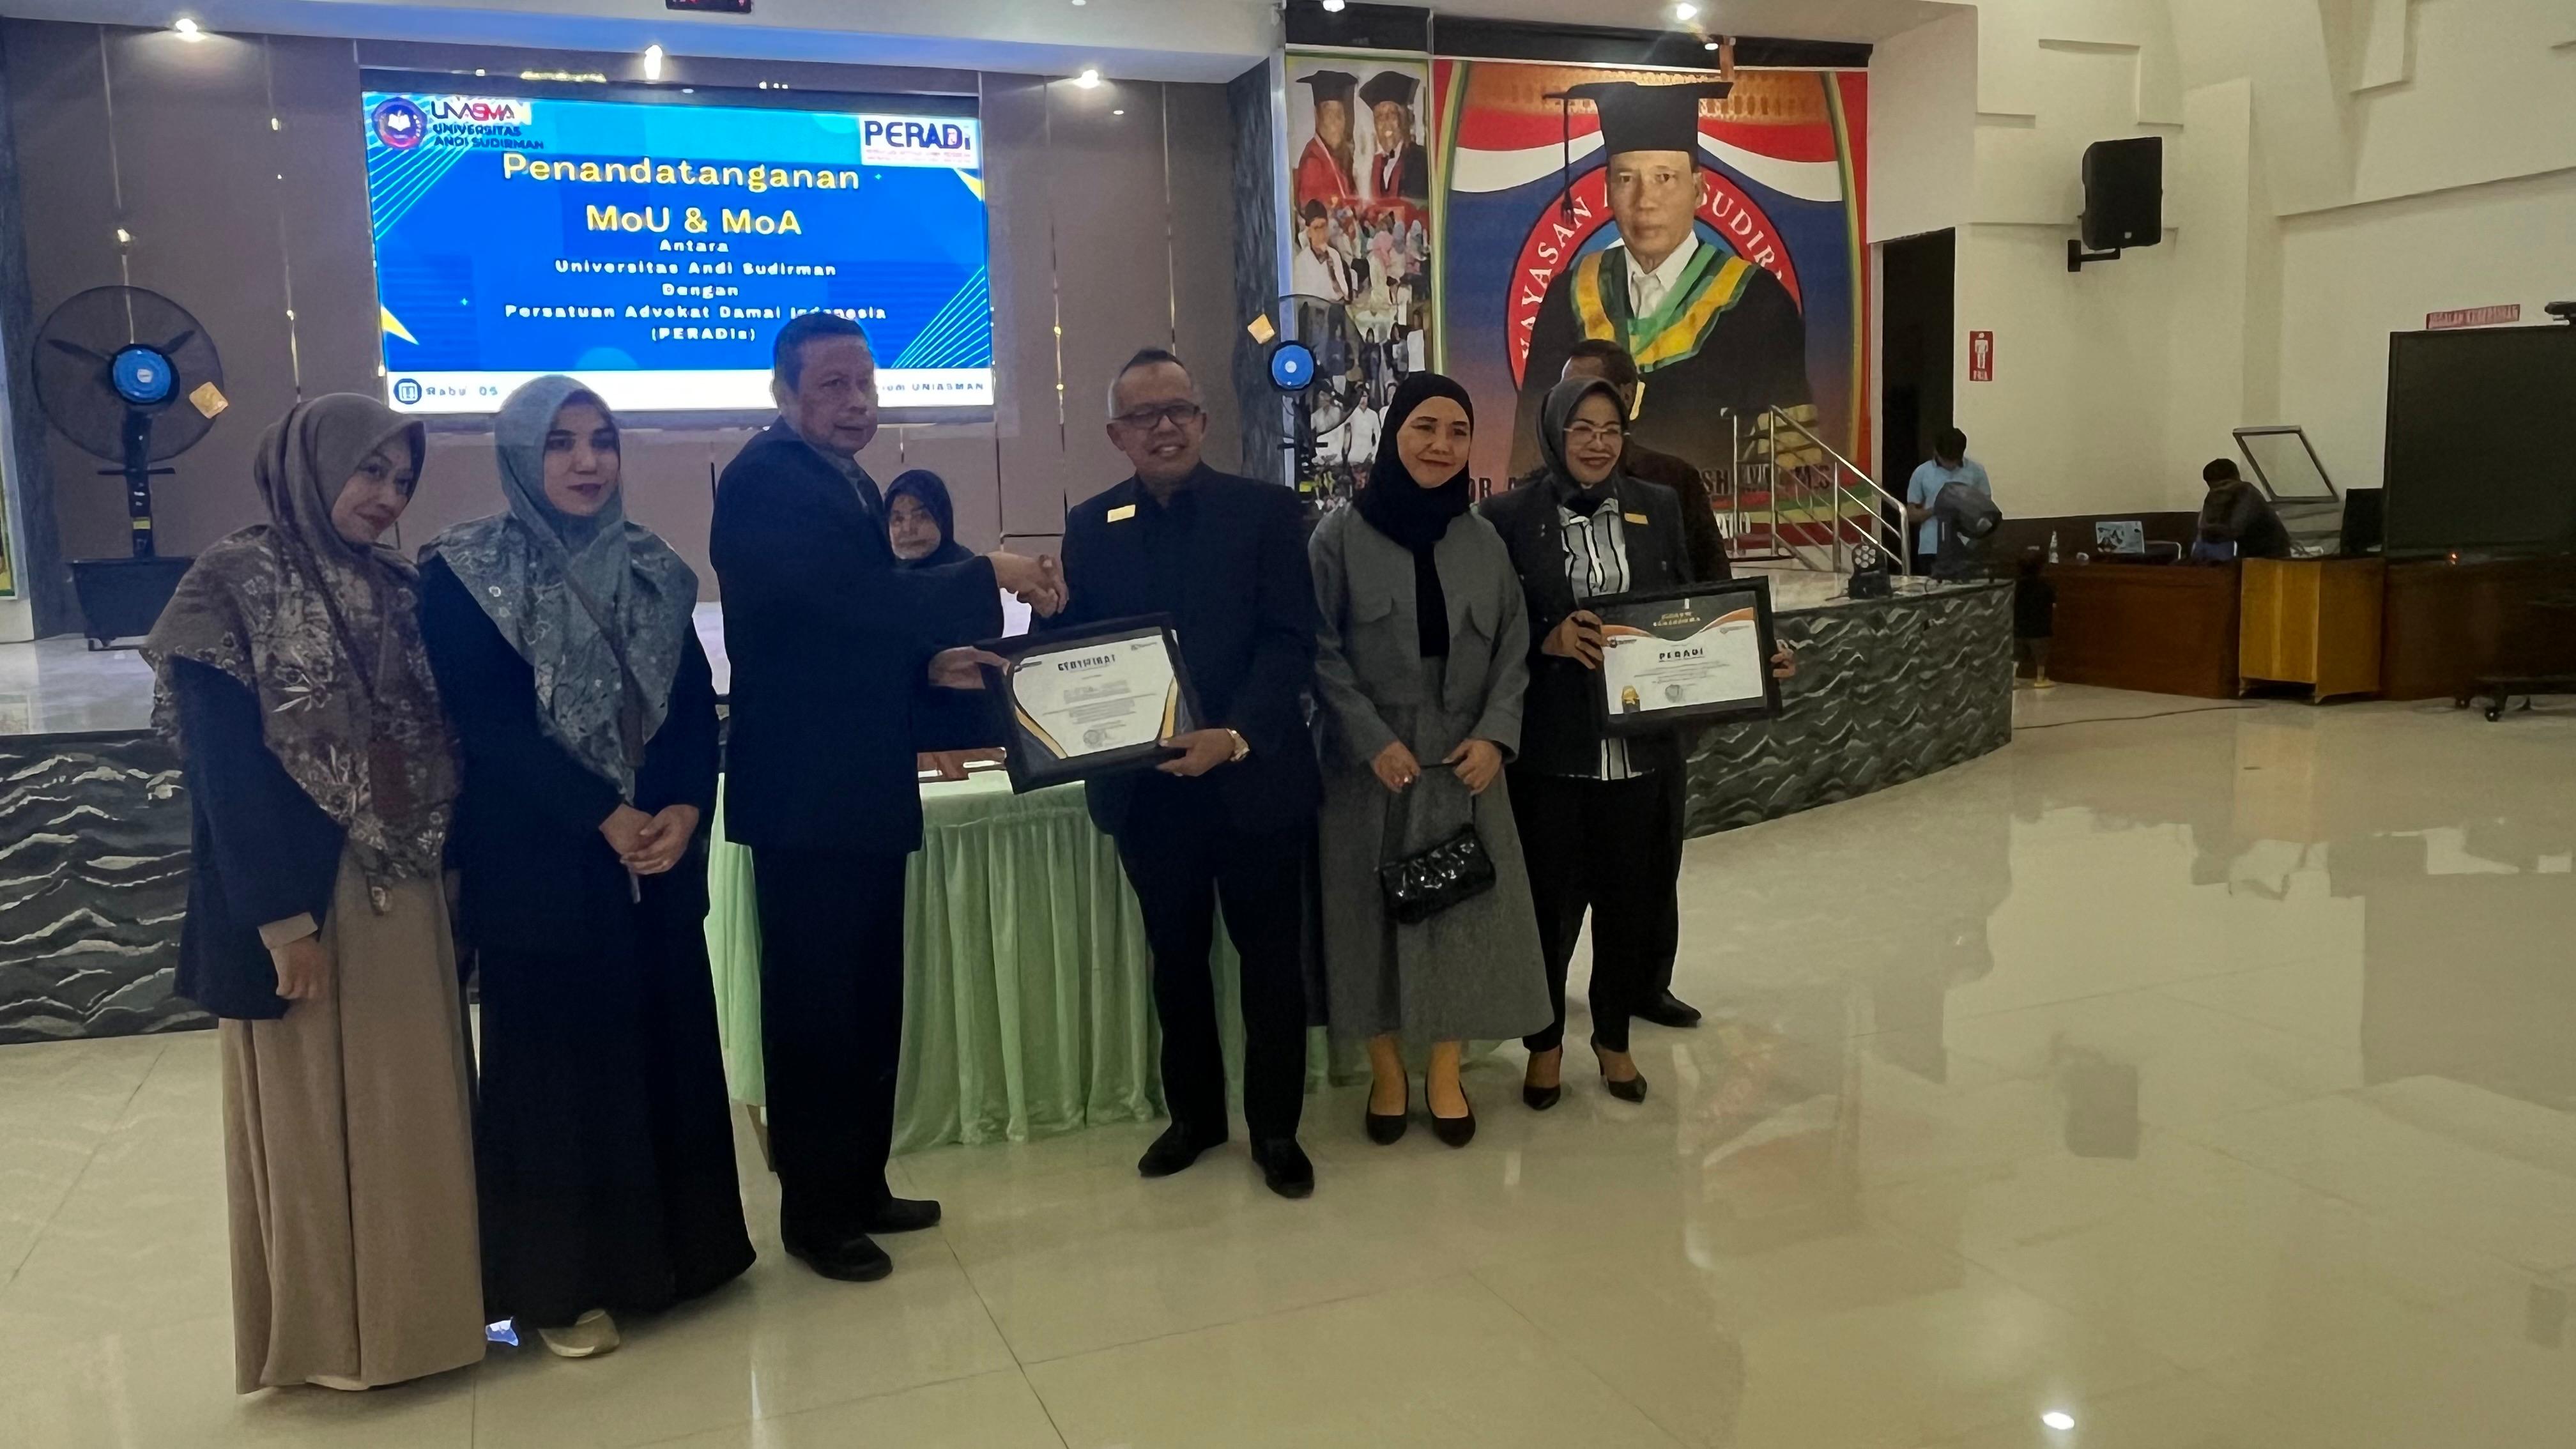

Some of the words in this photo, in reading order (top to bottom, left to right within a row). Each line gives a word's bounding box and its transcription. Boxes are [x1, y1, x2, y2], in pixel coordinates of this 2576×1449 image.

[433, 123, 521, 136] UNIVERSITAS
[434, 135, 468, 147] ANDI
[471, 137, 543, 149] SUDIRMAN
[503, 153, 859, 193] Penandatanganan
[586, 204, 670, 233] MoU
[684, 207, 707, 233] &
[722, 208, 802, 234] MoA
[659, 240, 728, 252] Antara
[555, 260, 678, 274] Universitas
[689, 262, 733, 274] Andi
[742, 263, 836, 275] Sudirman
[662, 283, 739, 299] Dengan
[505, 305, 615, 318] Persatuan
[625, 305, 709, 318] Advokat
[719, 306, 780, 319] Damai
